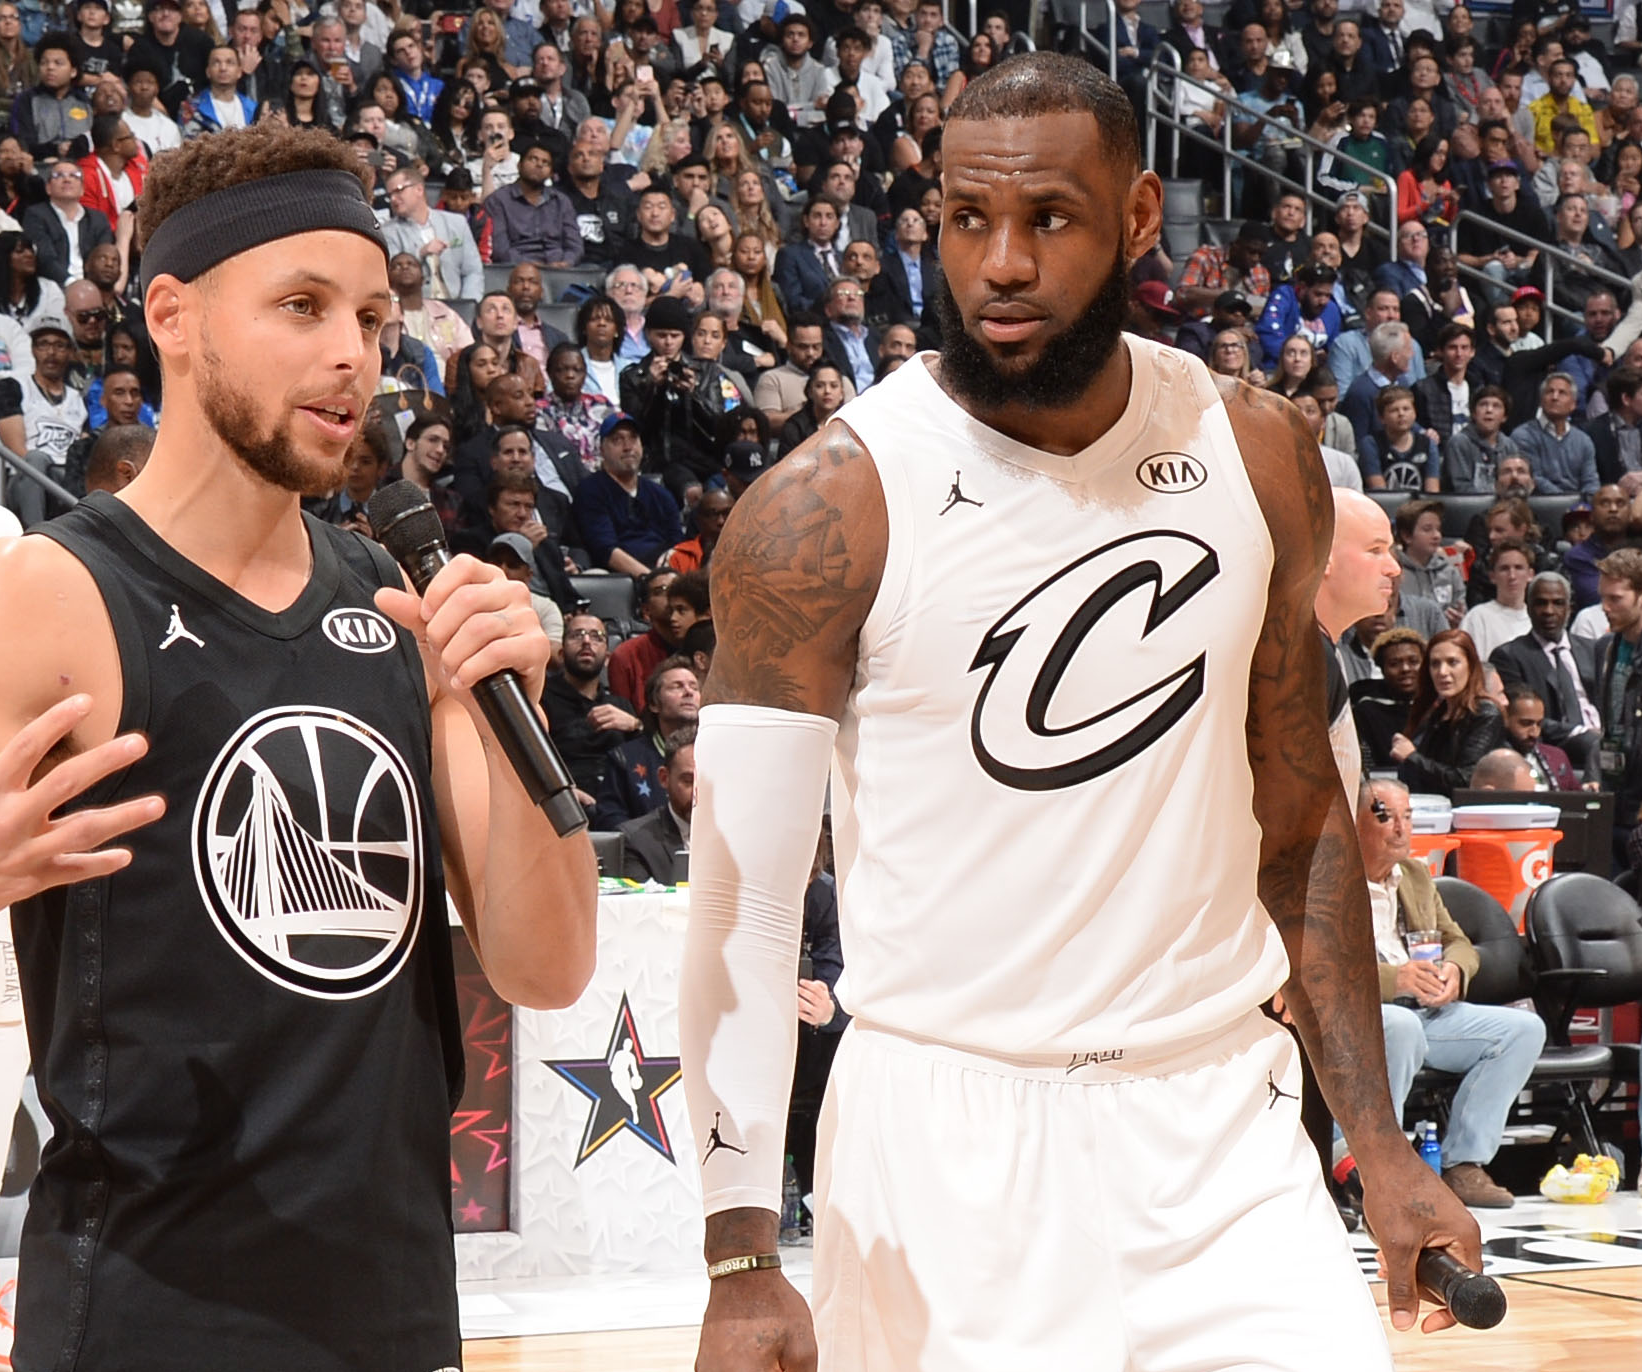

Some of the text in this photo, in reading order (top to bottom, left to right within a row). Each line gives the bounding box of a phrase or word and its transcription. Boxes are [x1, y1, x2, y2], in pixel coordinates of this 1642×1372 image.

[1147, 462, 1199, 485] KIA
[332, 617, 389, 643] KIA
[966, 529, 1220, 791] C
[1521, 849, 1550, 889] G
